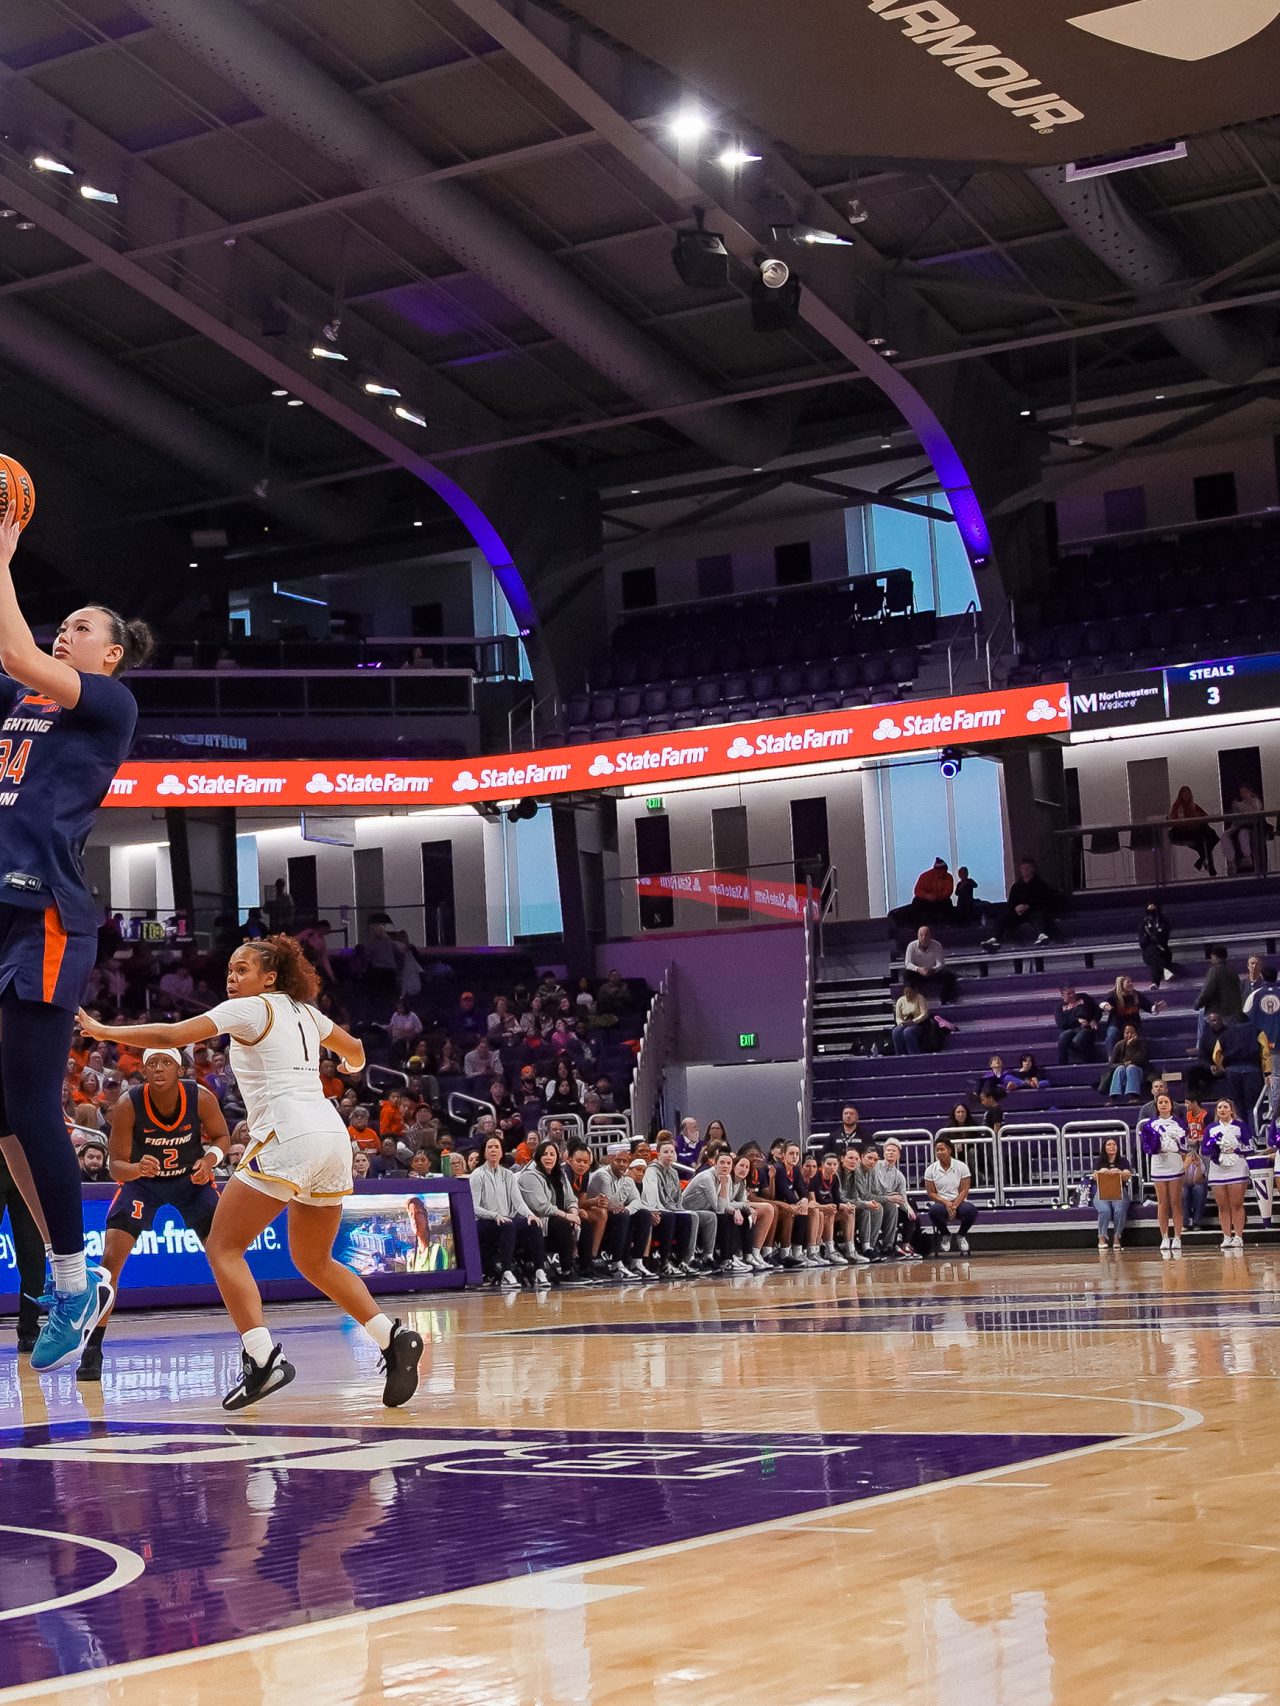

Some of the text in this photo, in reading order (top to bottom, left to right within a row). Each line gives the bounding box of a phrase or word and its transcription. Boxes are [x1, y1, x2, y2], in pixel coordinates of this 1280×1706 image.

[1189, 665, 1235, 681] STEALS
[1098, 687, 1159, 701] Northwestern
[1207, 686, 1221, 705] 3
[297, 1020, 310, 1062] 1
[740, 1034, 754, 1046] EXIT
[145, 1132, 193, 1147] FIGHTING
[162, 1148, 179, 1170] 2
